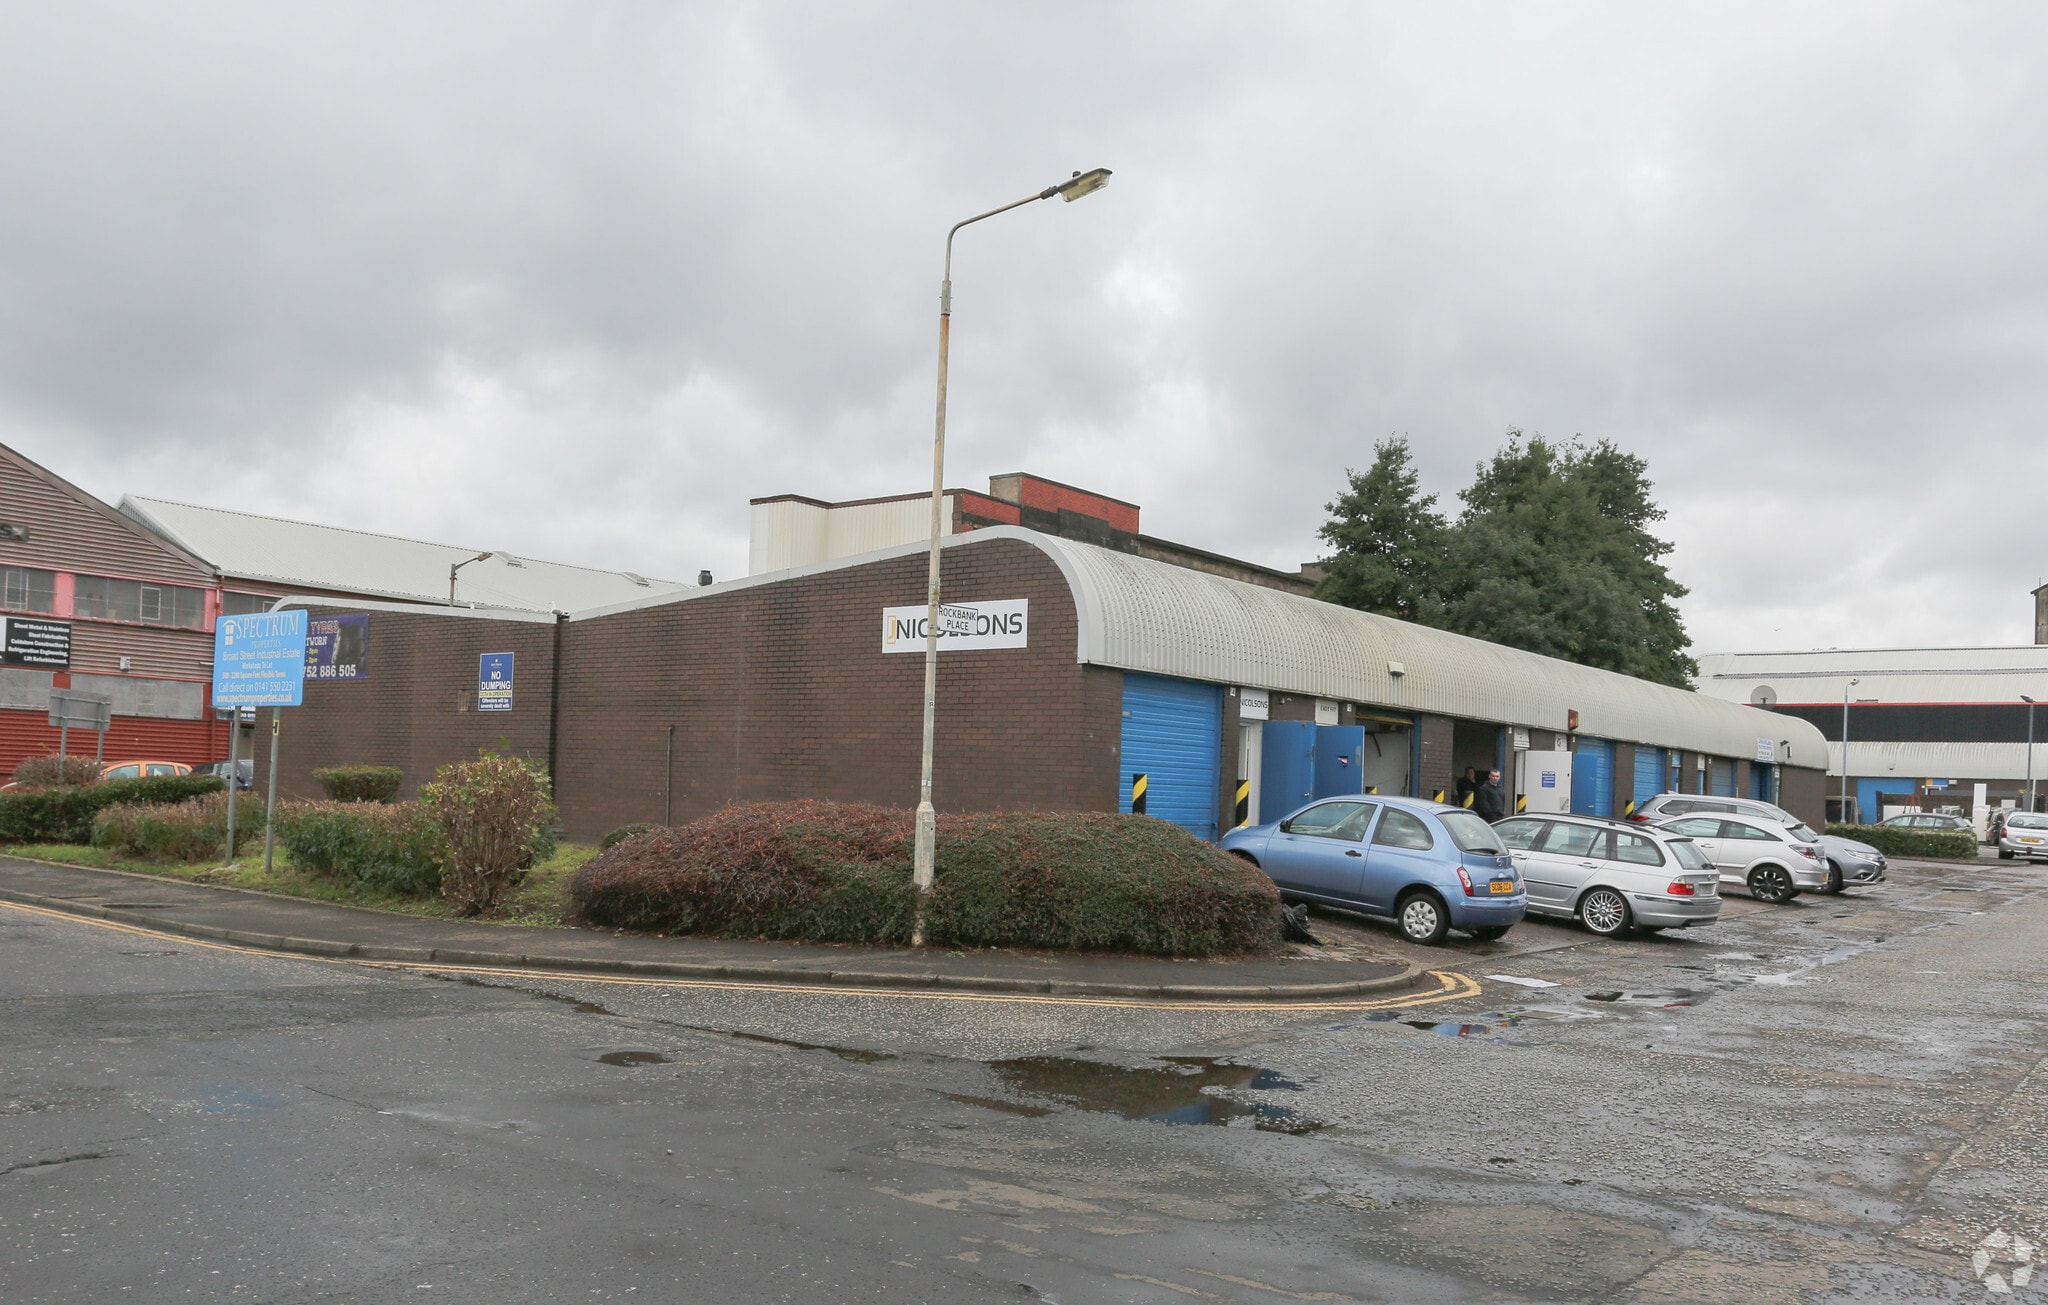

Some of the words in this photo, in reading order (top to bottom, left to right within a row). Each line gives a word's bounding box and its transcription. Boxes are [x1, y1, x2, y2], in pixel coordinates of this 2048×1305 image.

[938, 607, 976, 621] ROCKBANK
[48, 625, 70, 633] Stainless
[236, 613, 299, 639] SPECTRUM
[310, 620, 339, 635] TYRES
[896, 612, 1023, 639] NICONS
[946, 619, 969, 631] PLACE
[251, 639, 281, 649] PROPERTIES
[223, 651, 239, 661] Broad
[240, 649, 256, 661] Street
[257, 648, 281, 659] Industrial
[282, 647, 301, 658] Estate
[320, 665, 336, 678] 886
[339, 664, 356, 677] 505
[491, 670, 502, 680] NO
[218, 682, 229, 693] Call
[229, 681, 245, 693] direct
[245, 683, 254, 692] on
[254, 681, 268, 692] 0141
[281, 680, 296, 692] 2231
[481, 680, 511, 690] DUMPING
[216, 691, 293, 705] www.spectrumproperties.co.uk
